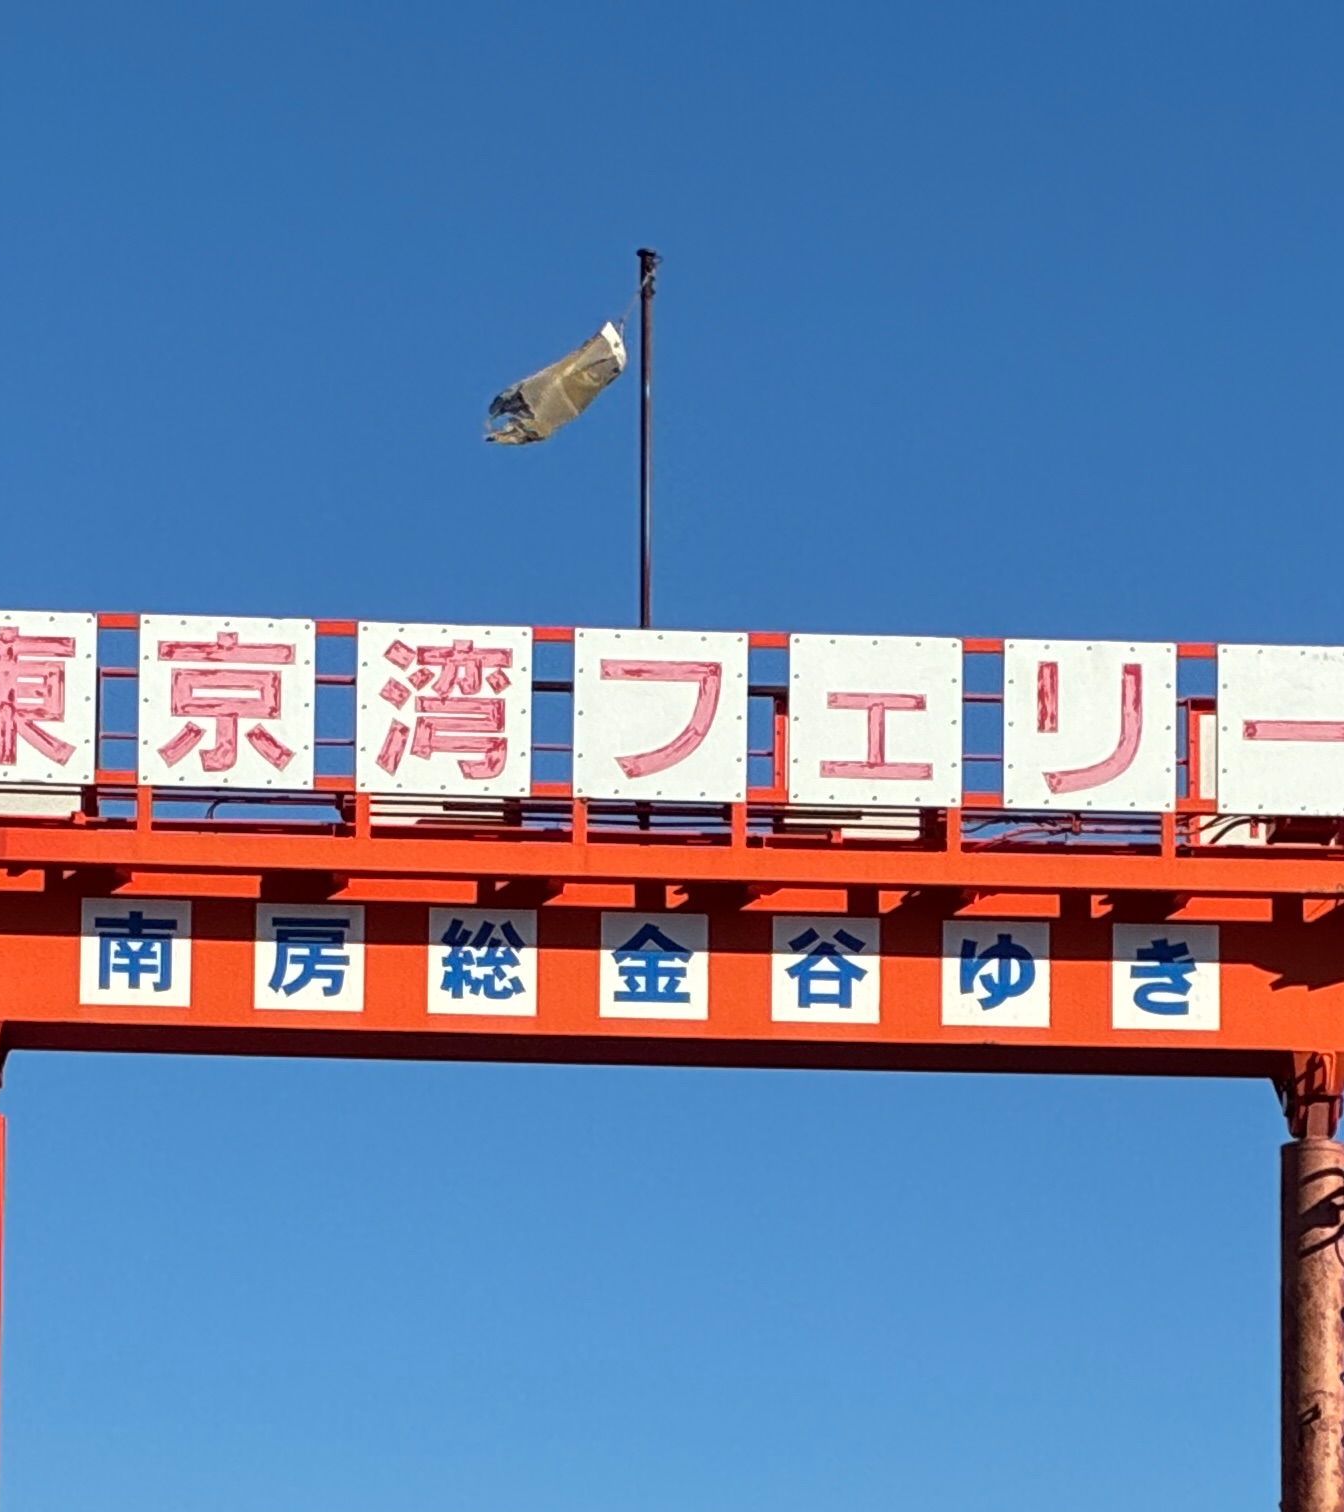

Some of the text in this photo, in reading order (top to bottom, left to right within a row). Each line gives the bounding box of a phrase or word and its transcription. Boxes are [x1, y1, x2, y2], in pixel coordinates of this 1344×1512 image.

[93, 909, 1198, 1016] 南房総金谷ゆき
